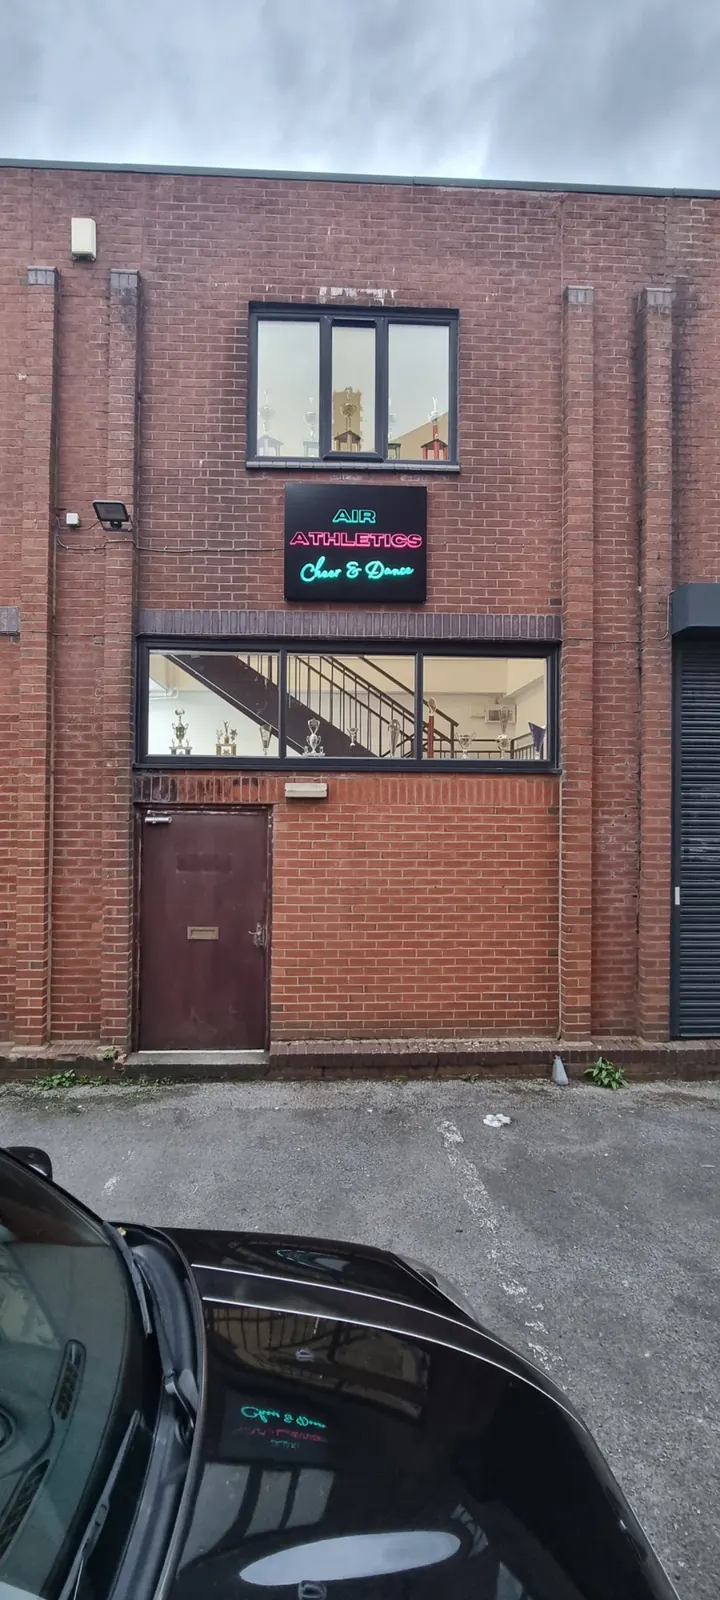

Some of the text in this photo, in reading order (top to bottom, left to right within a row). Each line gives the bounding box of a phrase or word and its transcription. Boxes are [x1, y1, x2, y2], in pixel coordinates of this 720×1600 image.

[332, 508, 376, 524] AIR
[289, 531, 422, 548] ATHLETICS
[300, 555, 414, 582] Cheer & Dance
